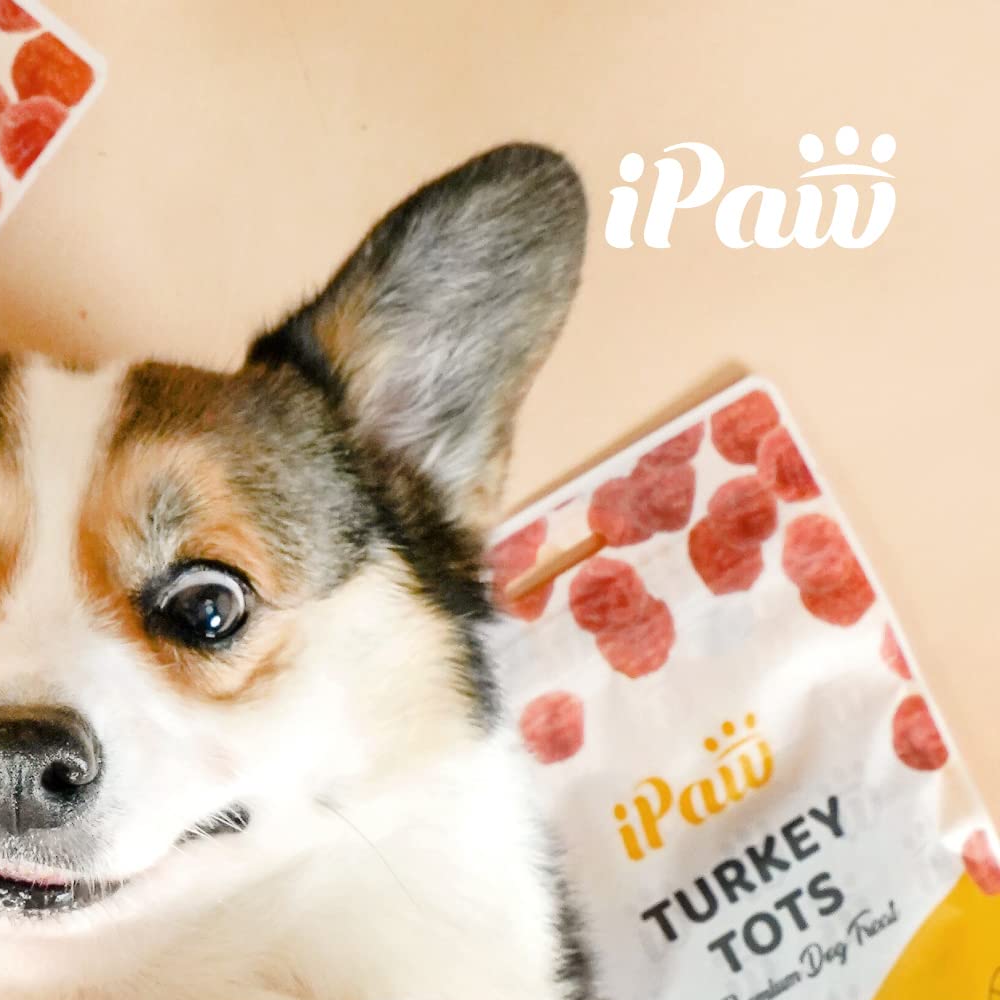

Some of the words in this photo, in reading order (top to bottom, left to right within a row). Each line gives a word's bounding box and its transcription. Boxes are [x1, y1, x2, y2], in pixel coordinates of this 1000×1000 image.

[613, 712, 775, 861] iPaw
[641, 795, 845, 942] TURKEY
[708, 871, 845, 973] TOTS
[799, 942, 848, 979] Dog
[847, 900, 899, 946] Treat
